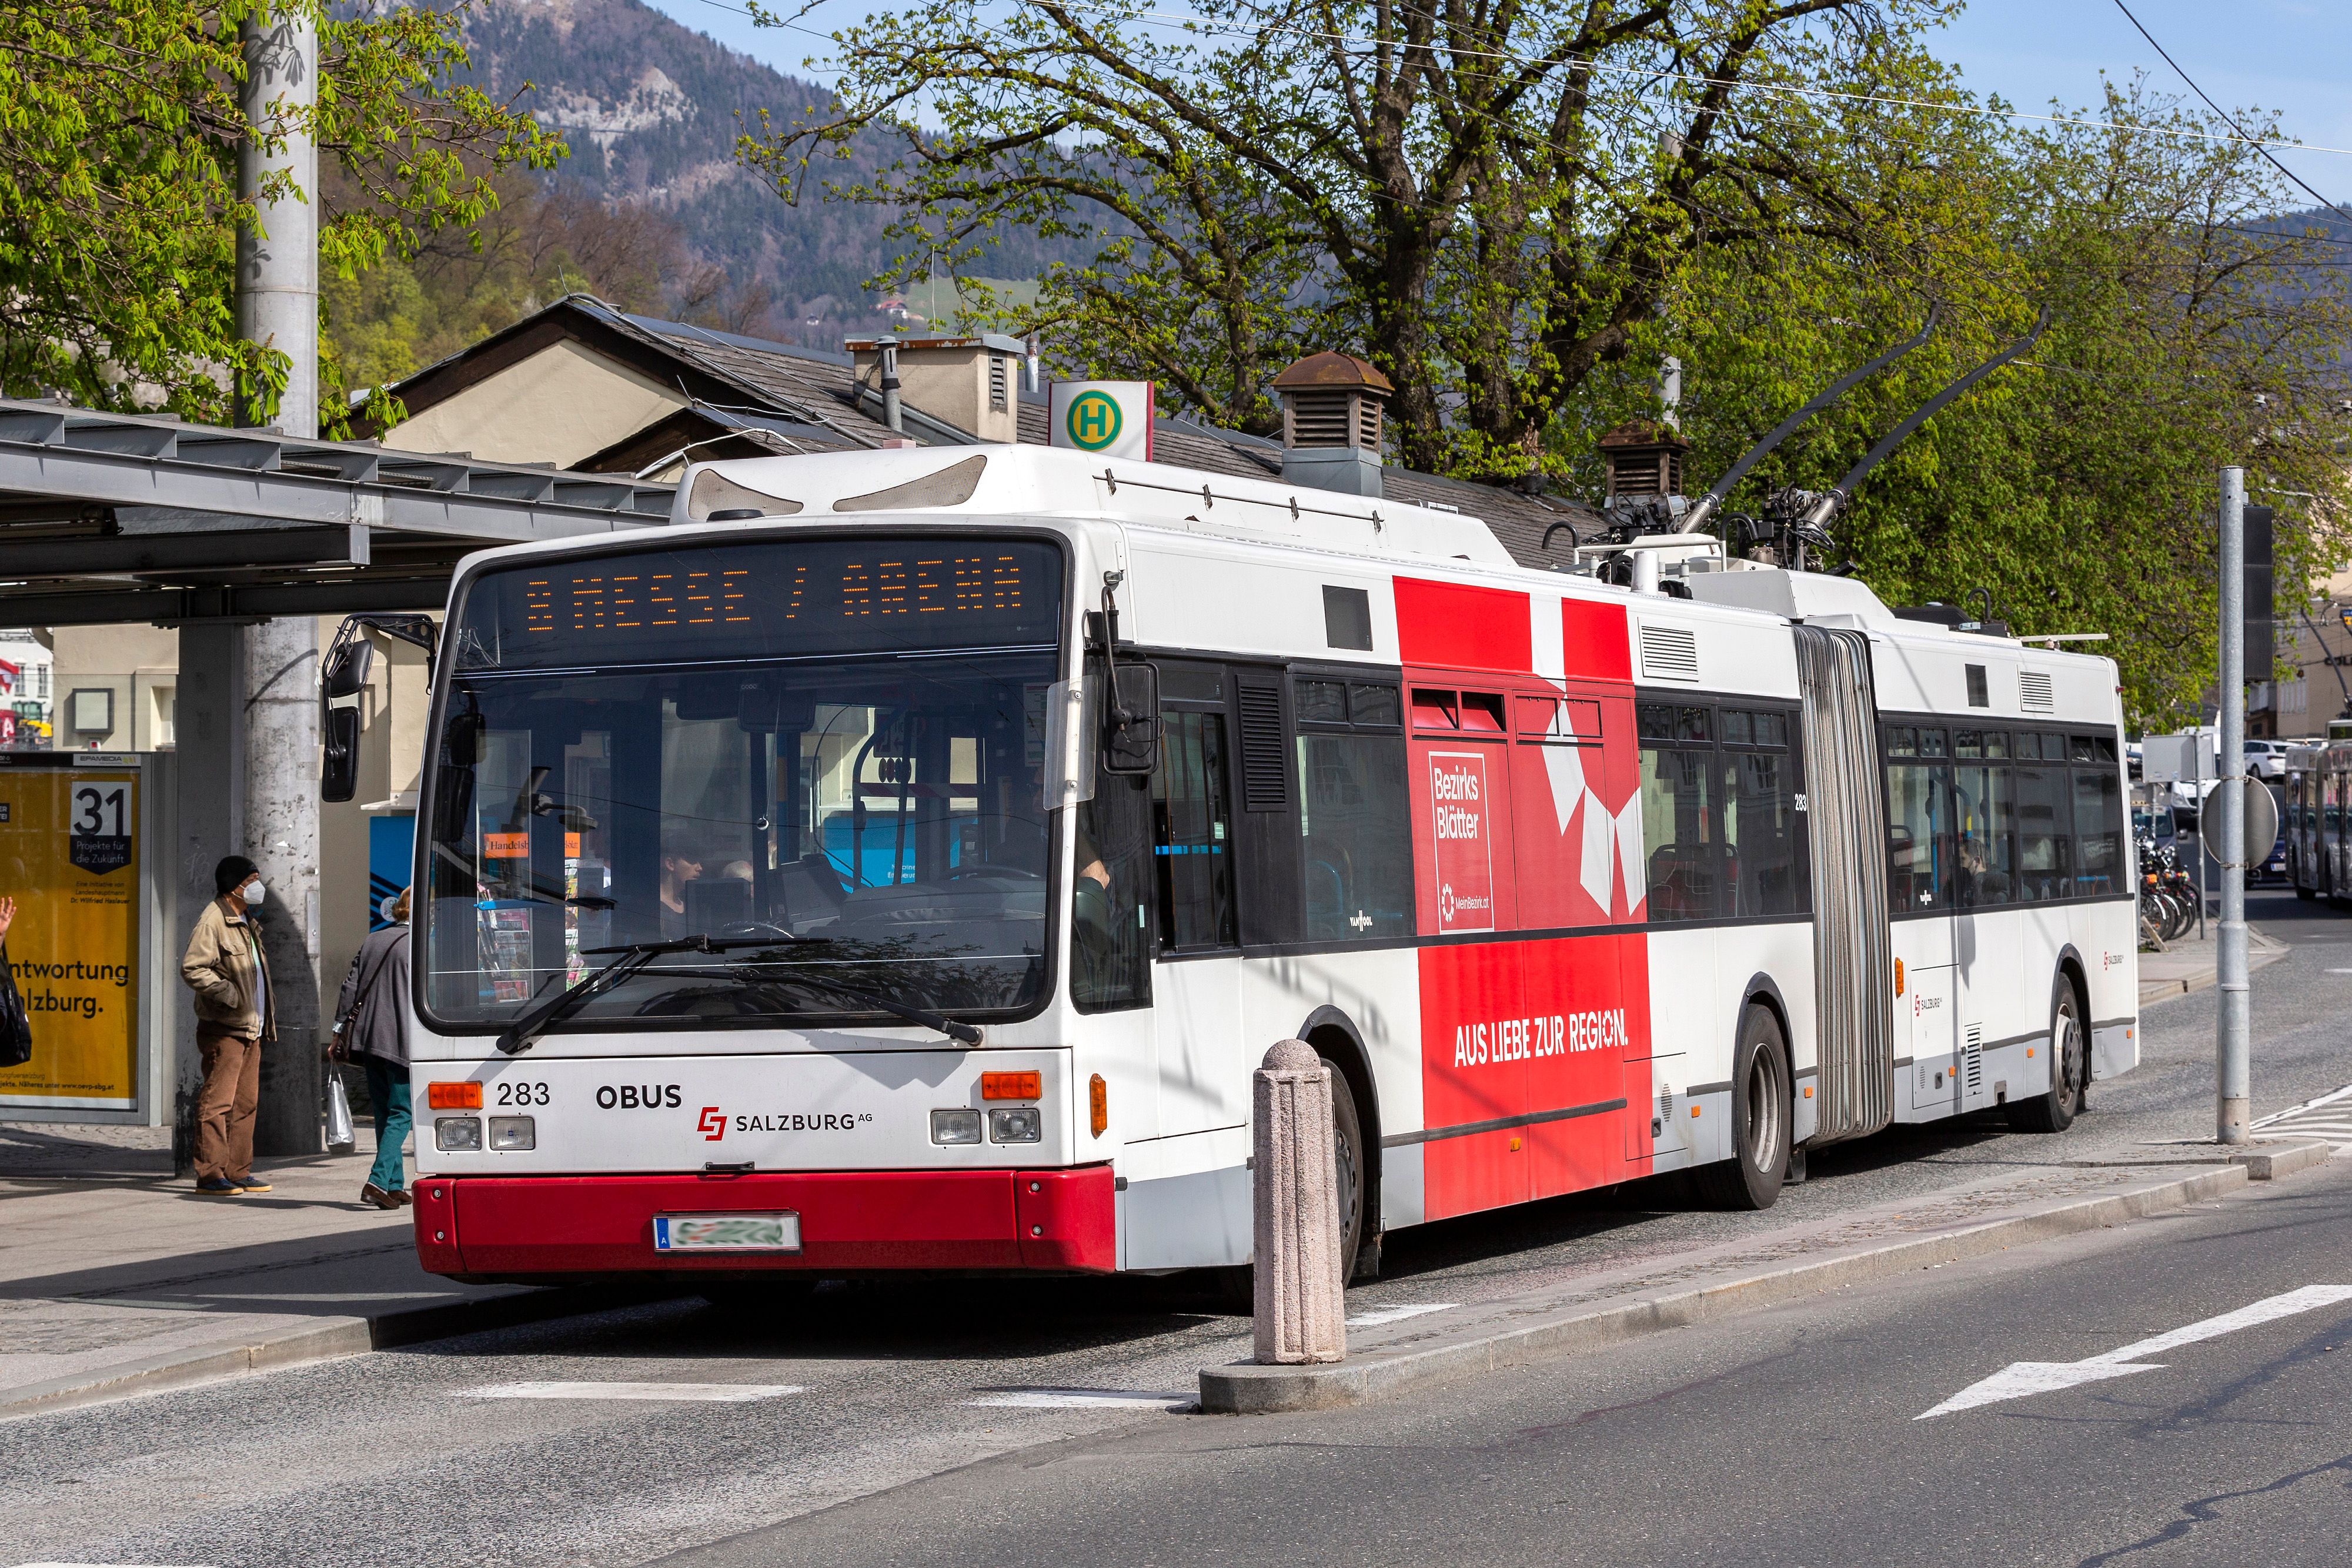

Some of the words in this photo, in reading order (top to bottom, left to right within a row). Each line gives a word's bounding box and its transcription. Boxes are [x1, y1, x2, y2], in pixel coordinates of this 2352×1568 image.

[1080, 404, 1106, 436] H
[573, 570, 751, 629] MESSE
[843, 556, 1020, 616] ARENA
[1434, 764, 1479, 801] Bezirks
[74, 787, 125, 835] 31
[1795, 793, 1807, 811] 283
[1436, 805, 1479, 839] Blätter
[76, 841, 111, 852] Projekte
[113, 841, 125, 850] für
[76, 854, 89, 863] die
[92, 854, 124, 864] Zukunft
[1455, 895, 1489, 910] MeinBezirk.at
[8, 959, 129, 987] ntwortung
[19, 988, 103, 1019] lzburg.
[1454, 1023, 1488, 1068] AUS
[1491, 1018, 1531, 1063] LIEBE
[1534, 1015, 1565, 1057] ZUR
[1569, 1008, 1628, 1053] REGION.
[497, 1082, 550, 1106] 283
[596, 1084, 682, 1109] OBUS
[736, 1114, 855, 1132] SALZBURG
[858, 1113, 873, 1122] AG
